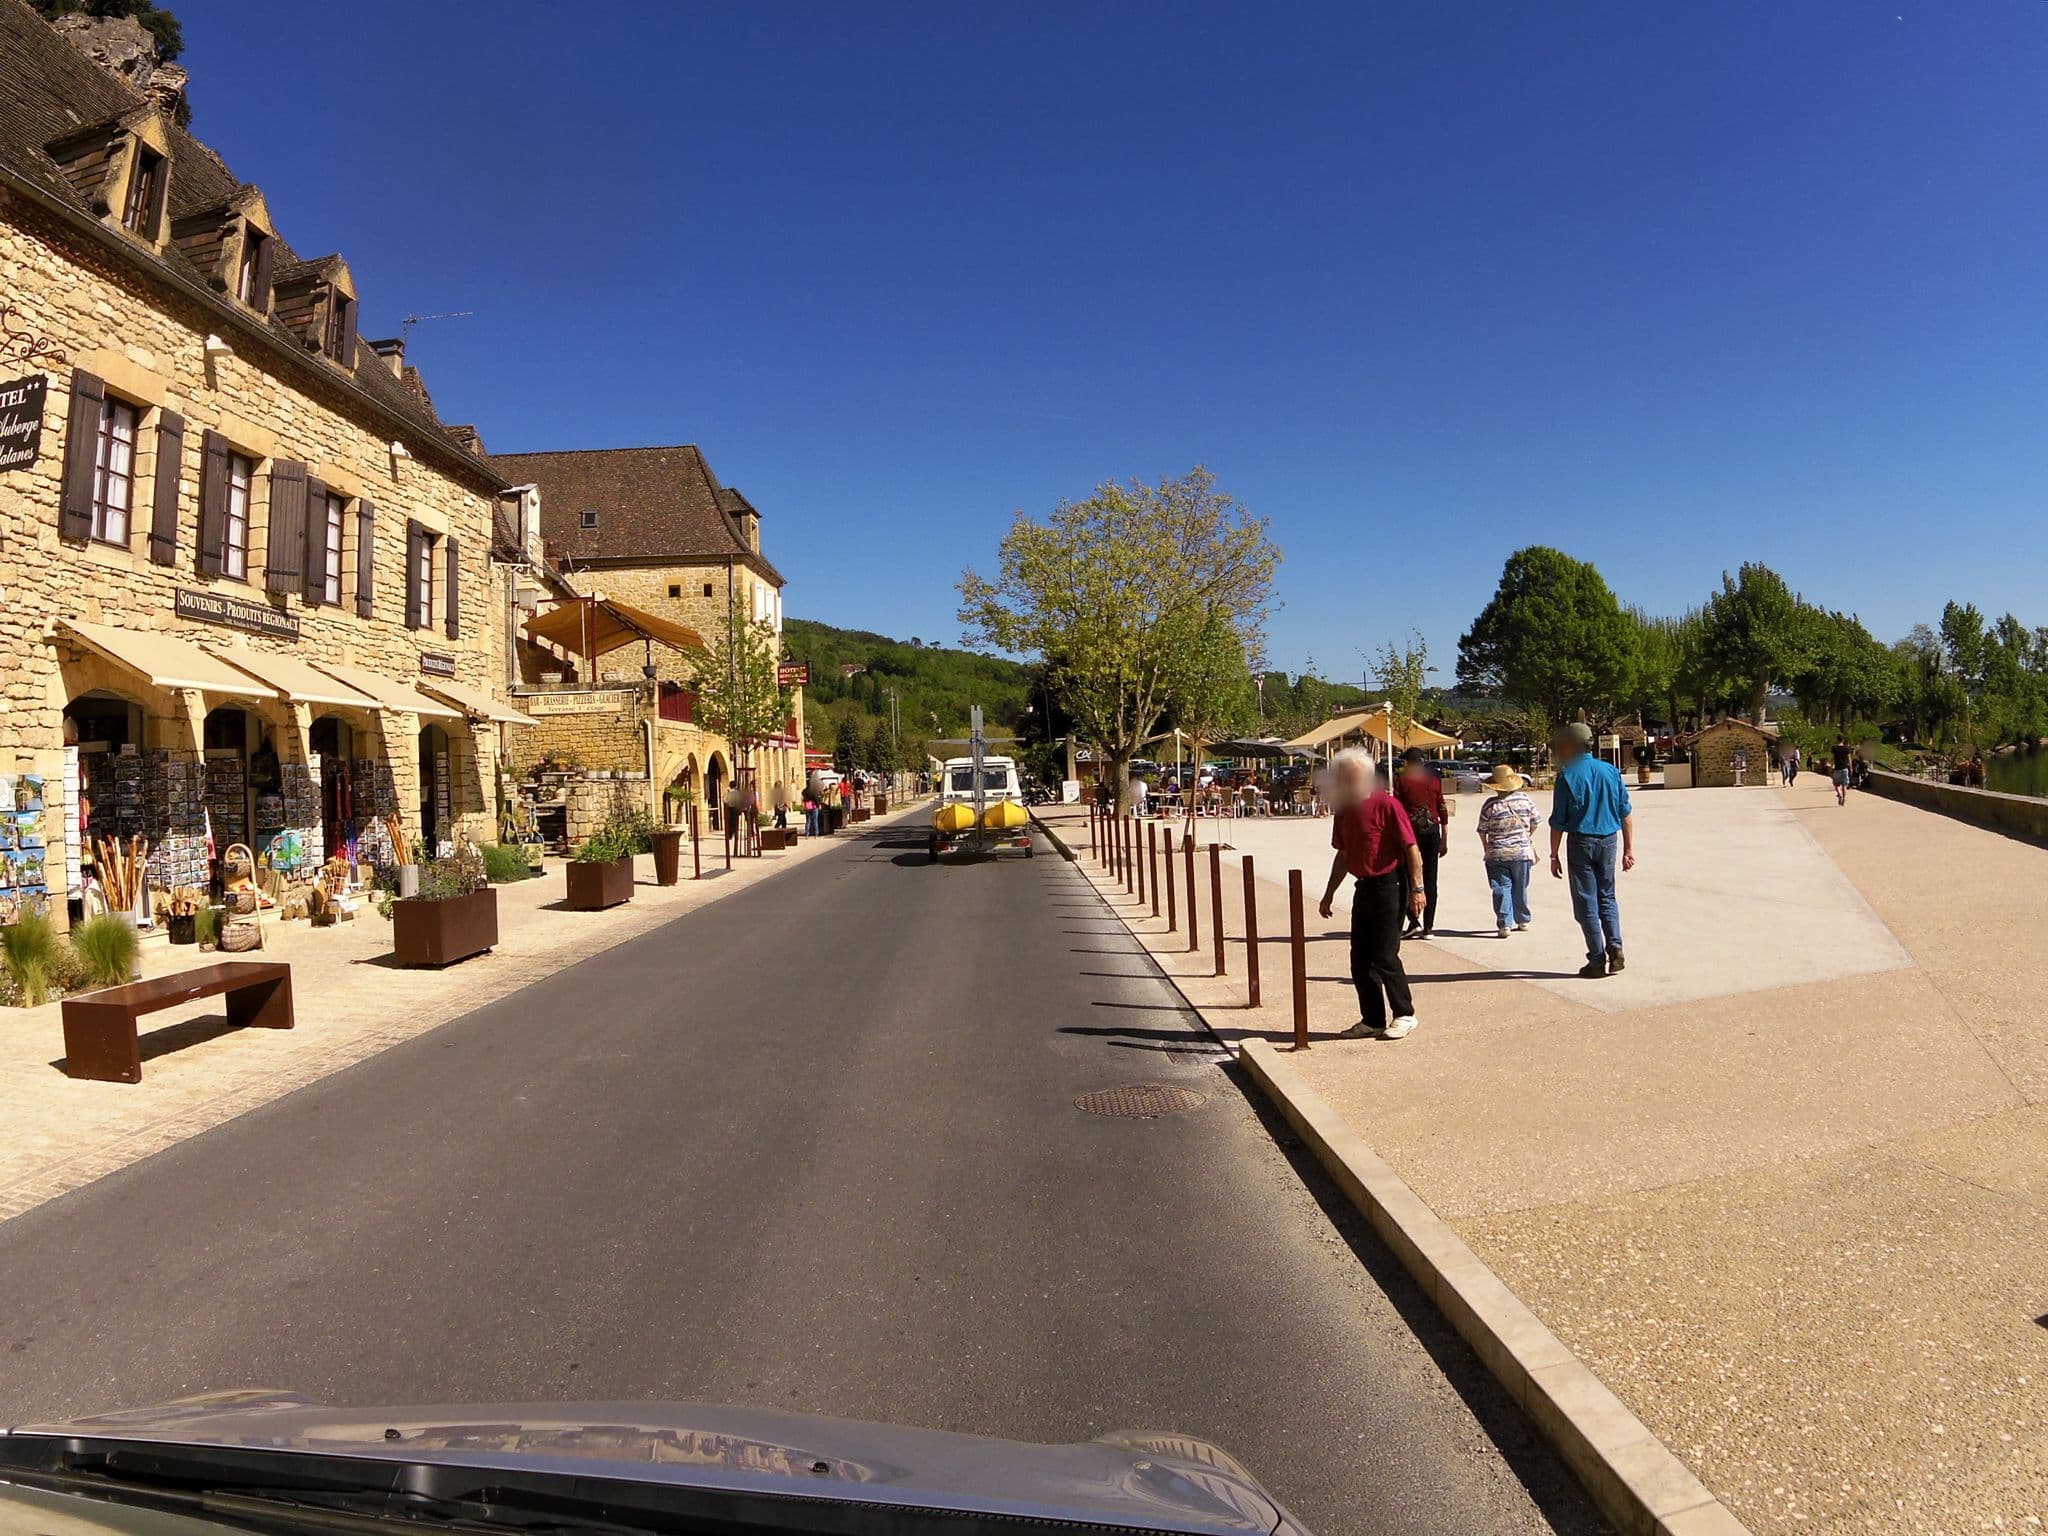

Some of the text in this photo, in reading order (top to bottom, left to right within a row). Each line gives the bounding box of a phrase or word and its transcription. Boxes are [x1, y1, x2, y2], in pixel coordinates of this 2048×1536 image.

[180, 590, 223, 614] SOUVENIRS
[226, 602, 261, 622] PRODUITS
[262, 610, 299, 631] RÉGIONAUX
